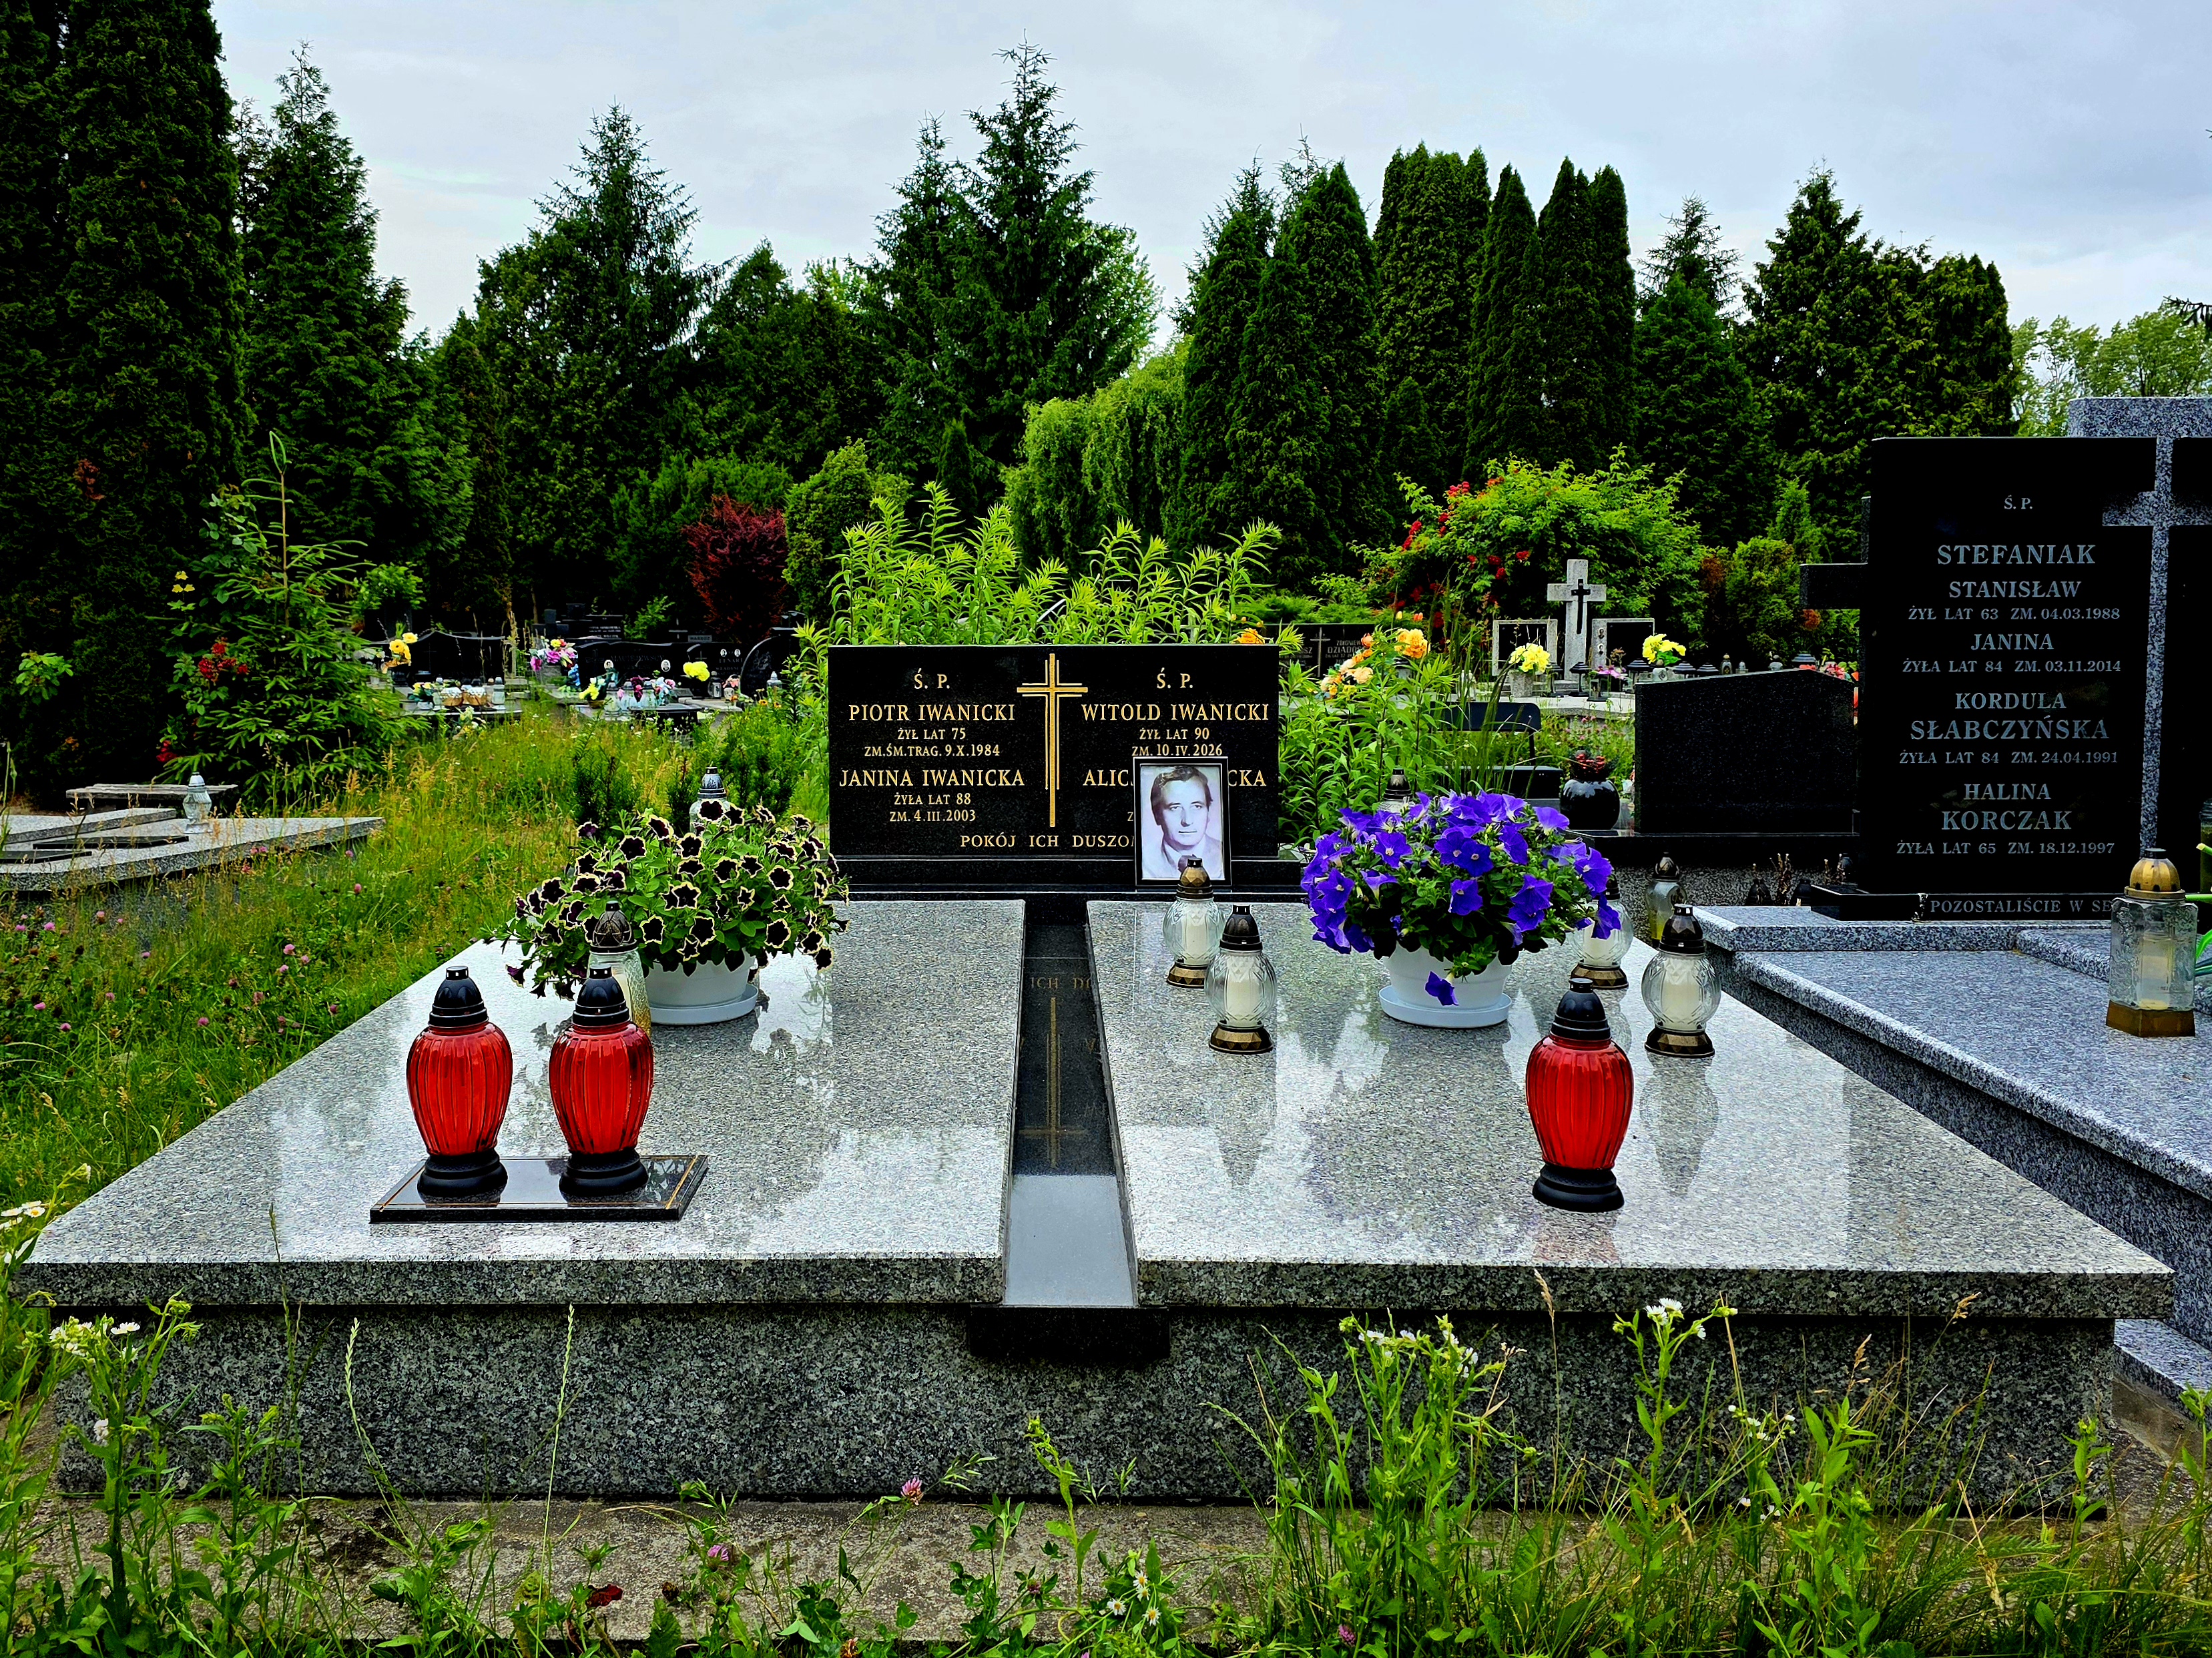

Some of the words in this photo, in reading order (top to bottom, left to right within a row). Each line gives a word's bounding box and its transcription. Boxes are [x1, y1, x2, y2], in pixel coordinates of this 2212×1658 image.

[2004, 495, 2016, 509] Ś.
[2021, 498, 2032, 509] P.
[1938, 545, 2095, 564] STEFANIAK
[1950, 581, 2081, 597] STANISŁAW
[1909, 605, 1936, 619] ŻYŁ
[1945, 609, 1973, 619] LAT
[1981, 609, 1998, 619] 63
[2011, 608, 2036, 619] ZM.
[2041, 608, 2120, 619] 04.03.1988
[1971, 634, 2054, 650] JANINA
[1903, 658, 1940, 671] ŻYŁA
[1949, 661, 1977, 671] LAT
[1986, 661, 2002, 671] 84
[2015, 661, 2040, 671] ZM.
[2046, 661, 2120, 671] 03.11.2014
[914, 668, 928, 689] Ś.
[938, 674, 950, 689] P.
[1157, 667, 1171, 688] Ś.
[1180, 673, 1193, 688] P.
[1955, 693, 2066, 709] KORDULA
[849, 705, 909, 721] PIOTR
[918, 704, 1015, 721] IWANICKI
[1081, 704, 1160, 720] WITOLD
[1171, 704, 1268, 720] IWANICKI
[898, 730, 918, 739] ŻYŁ
[924, 730, 945, 739] LAT
[952, 728, 965, 739] 75
[1140, 728, 1160, 739] ŻYŁ
[1167, 730, 1187, 739] LAT
[1195, 728, 1209, 740] 90
[1911, 715, 2108, 740] SŁABCZYŃSKA
[1132, 746, 1153, 756] ZM.
[1900, 750, 1936, 763] ŻYŁA
[1946, 752, 1974, 763] LAT
[1982, 753, 1998, 763] 84
[2012, 752, 2036, 762] ZM.
[2042, 752, 2117, 762] 24.04.1991
[840, 770, 913, 786] JANINA
[922, 770, 1025, 786] IWANICKA
[1083, 769, 1134, 786] ALIC
[894, 792, 922, 804] ŻYŁA
[928, 795, 950, 804] LAT
[956, 793, 971, 804] 88
[1964, 784, 2050, 800] HALINA
[890, 812, 910, 821] ZM.
[1942, 811, 2071, 830] KORCZAK
[960, 832, 1015, 847] POKÓJ
[1029, 835, 1059, 847] ICH
[1897, 840, 1934, 854] ŻYŁA
[1943, 843, 1970, 853] LAT
[1979, 843, 1995, 853] 65
[2008, 843, 2033, 853] ZM.
[2040, 843, 2114, 853] 18.12.1997
[1931, 898, 2060, 912] POZOSTALIŚCIE
[2070, 900, 2083, 912] W
